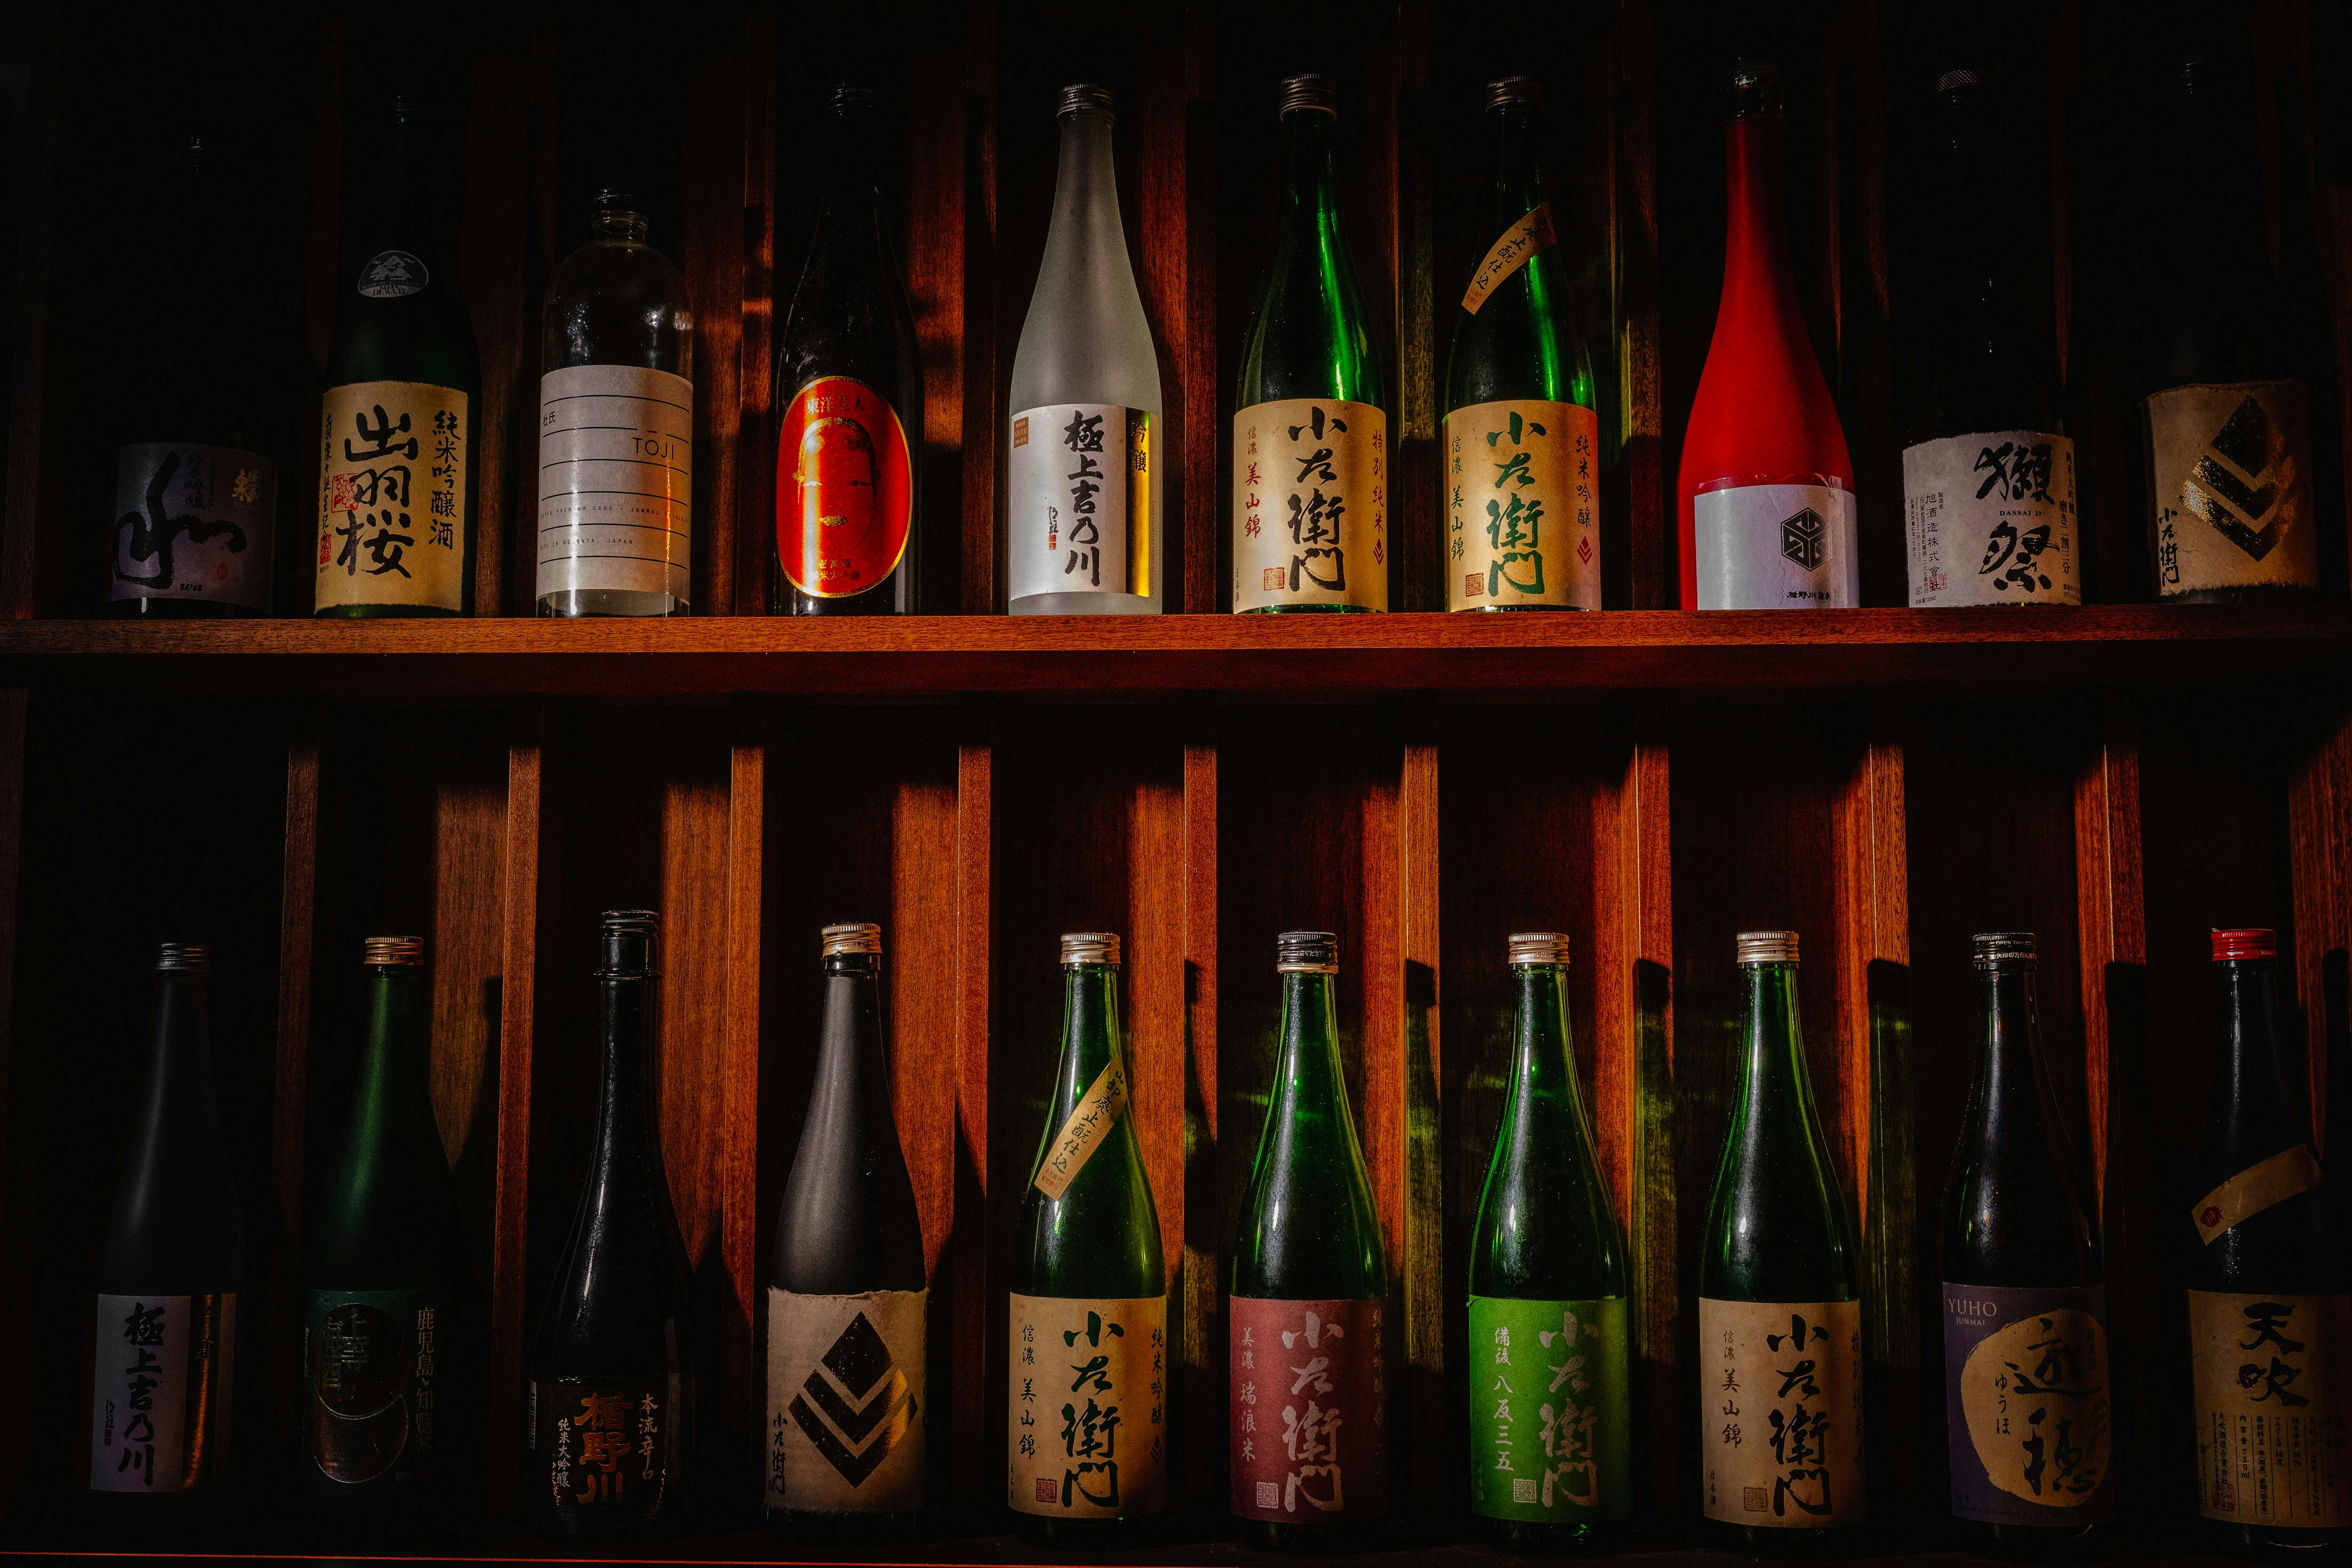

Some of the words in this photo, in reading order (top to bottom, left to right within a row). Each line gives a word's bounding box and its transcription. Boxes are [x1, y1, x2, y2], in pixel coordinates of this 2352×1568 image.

[543, 411, 556, 427] 杜氏
[806, 396, 866, 415] 東洋人
[1130, 420, 1147, 473] 吟醸
[335, 404, 418, 578] 出羽桜
[429, 410, 462, 549] 純米吟醸酒
[1064, 410, 1105, 587] 極上吉乃川
[1287, 406, 1348, 592] 小左衛門
[1372, 429, 1384, 533] 特別純米
[1486, 411, 1547, 597] 小左衛門
[1576, 435, 1592, 528] 純米吟醸
[2059, 500, 2071, 574] 磨き二割三分
[2159, 507, 2180, 587] 小左衛門
[180, 582, 203, 592] wa
[1948, 1297, 1997, 1317] YUHO
[1955, 1317, 1986, 1327] JUNMAI
[2238, 1301, 2309, 1408] 天吹
[117, 1302, 166, 1486] 極上吉乃川
[1061, 1311, 1125, 1508] 小左衛門
[1151, 1326, 1164, 1425] 純米吟醸
[1281, 1311, 1344, 1513] 小左衛門
[1539, 1311, 1599, 1508] 小左衛門
[1766, 1314, 1833, 1517] 小左衛門
[1994, 1373, 2010, 1435] ゆうほ
[556, 1417, 571, 1488] 純米大吟醸
[573, 1392, 634, 1504] 楯野川
[638, 1393, 659, 1480] 本流辛口
[772, 1411, 788, 1495] 小左衛門
[2256, 1416, 2265, 1446] 原材料名
